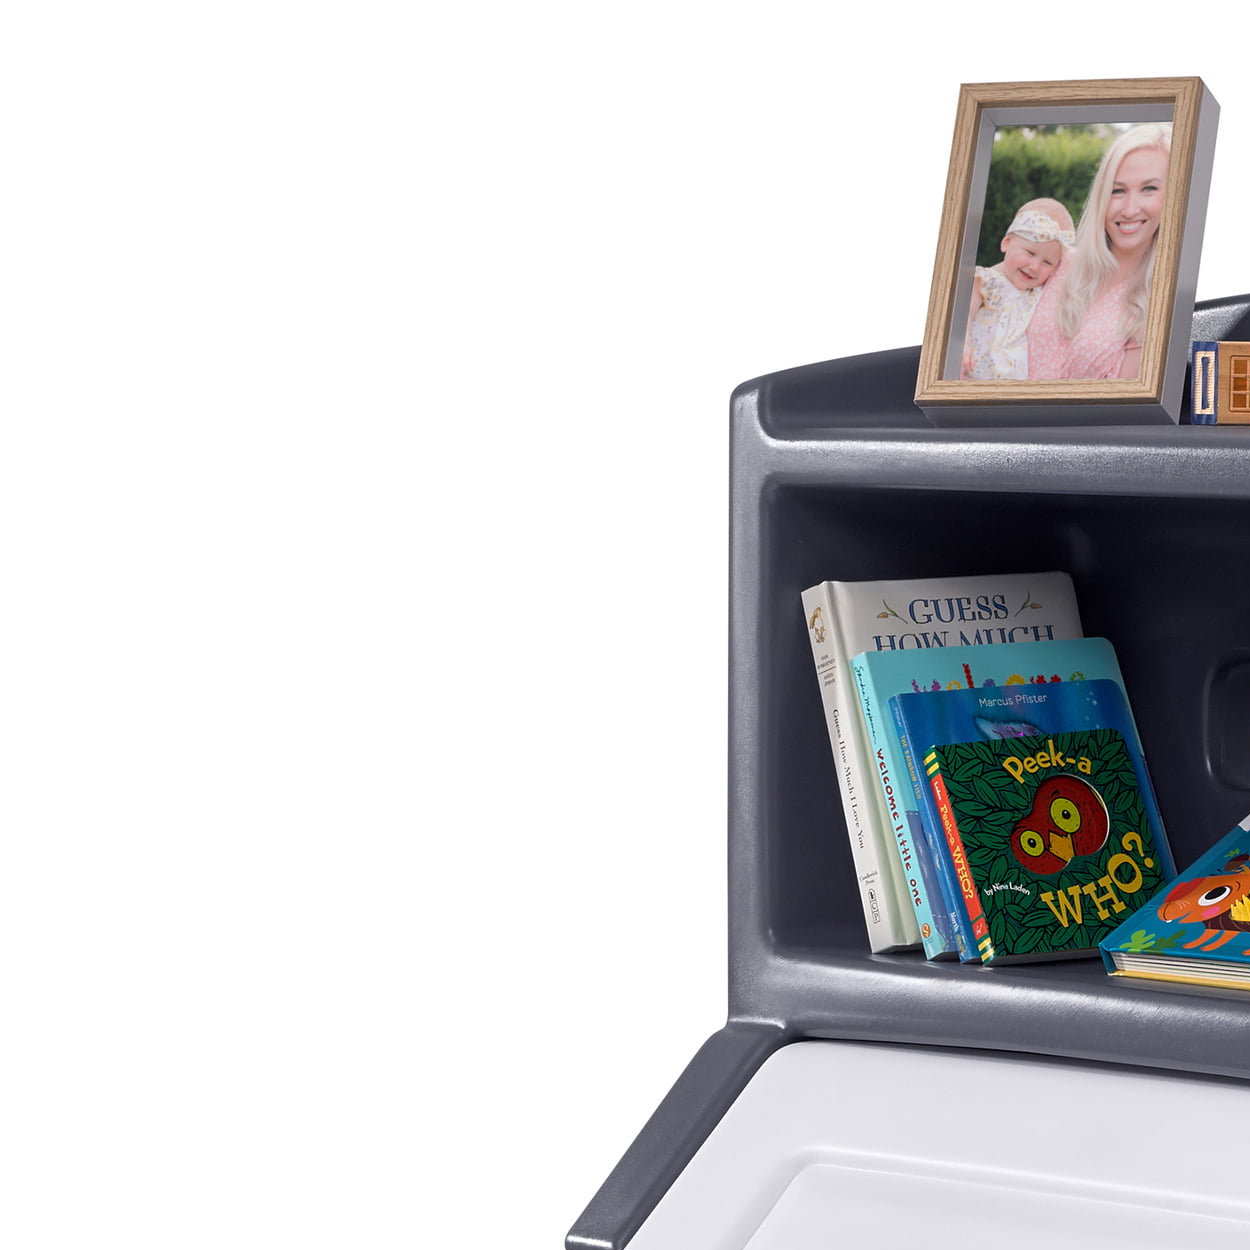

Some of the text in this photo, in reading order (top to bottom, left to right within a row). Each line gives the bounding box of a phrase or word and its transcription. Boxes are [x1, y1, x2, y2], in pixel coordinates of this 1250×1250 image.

[908, 594, 1009, 625] GUESS
[872, 625, 1054, 652] HOW MUCH
[978, 694, 1048, 707] Marcus Pfister
[833, 708, 842, 738] Guess
[839, 740, 847, 765] How
[844, 766, 853, 794] Much
[852, 804, 860, 828] Love
[1002, 739, 1092, 784] Peek-a
[876, 748, 922, 907] welcome little one
[940, 804, 974, 900] Peek-a WHO?
[983, 881, 1031, 896] by Nina Laden
[1040, 831, 1154, 928] WHO?
